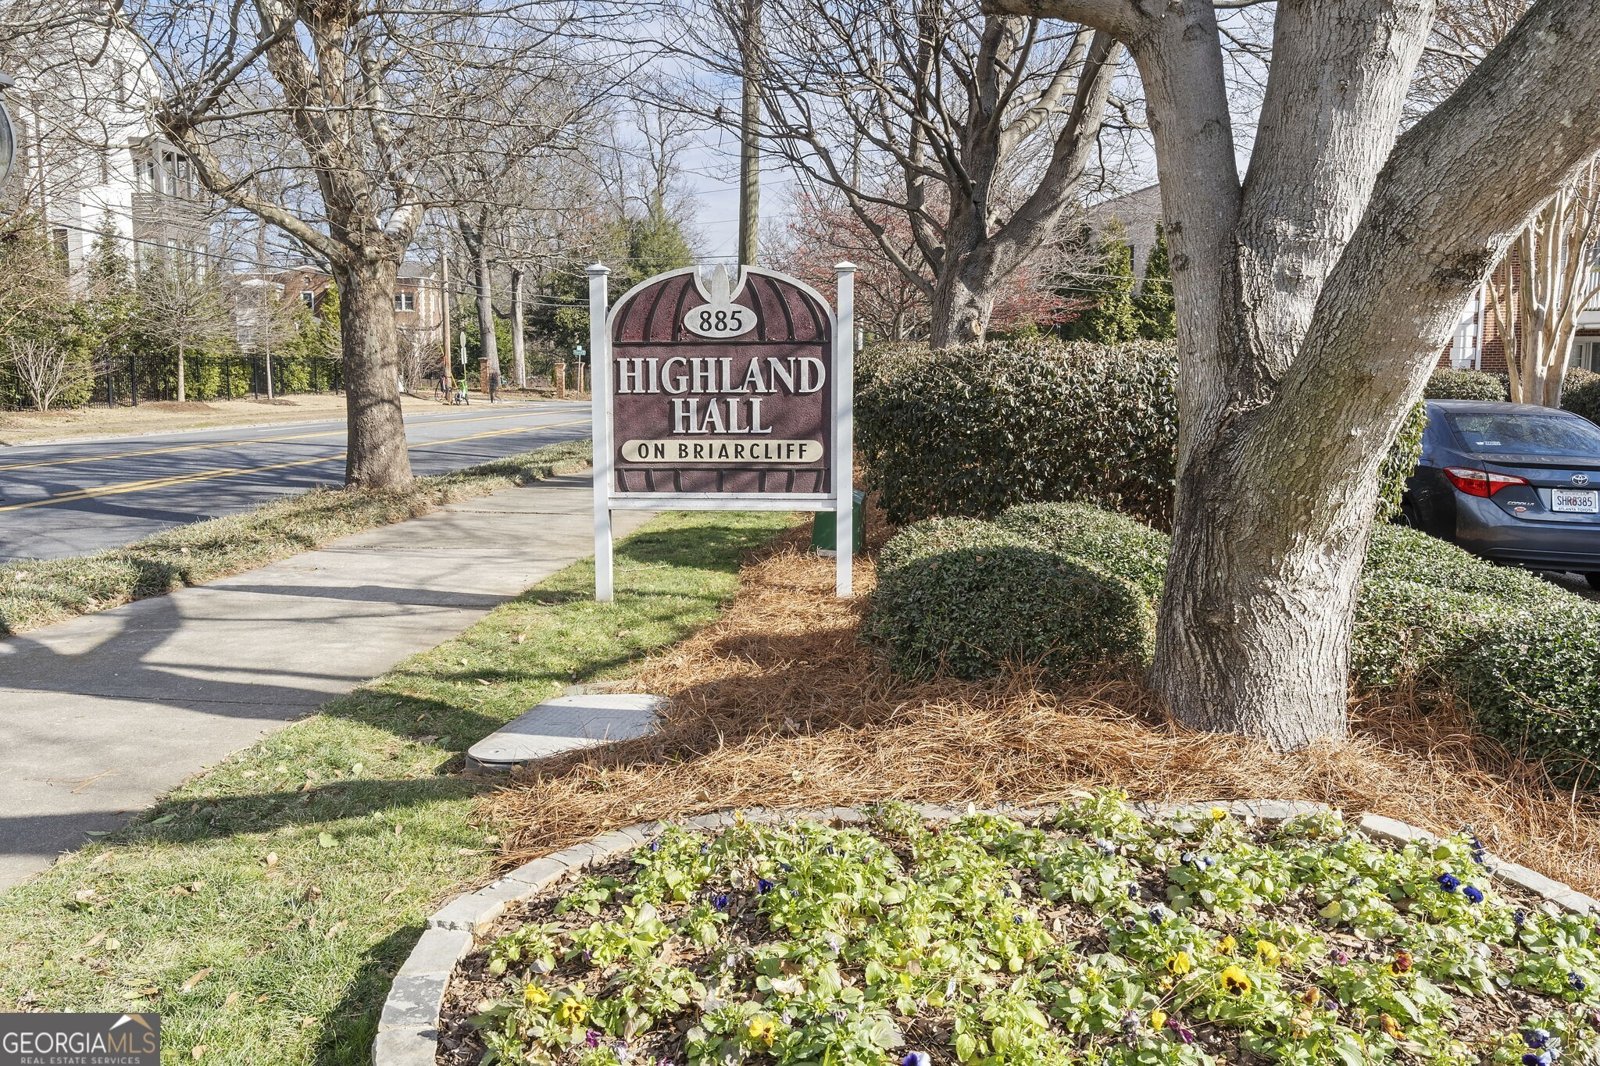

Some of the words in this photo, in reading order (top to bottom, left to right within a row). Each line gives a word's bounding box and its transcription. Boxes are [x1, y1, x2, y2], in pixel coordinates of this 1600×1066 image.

[699, 310, 743, 332] 885
[616, 357, 826, 393] HIGHLAND
[672, 397, 772, 434] HALL
[637, 443, 666, 459] ON
[678, 443, 808, 459] BRIARCLIFF
